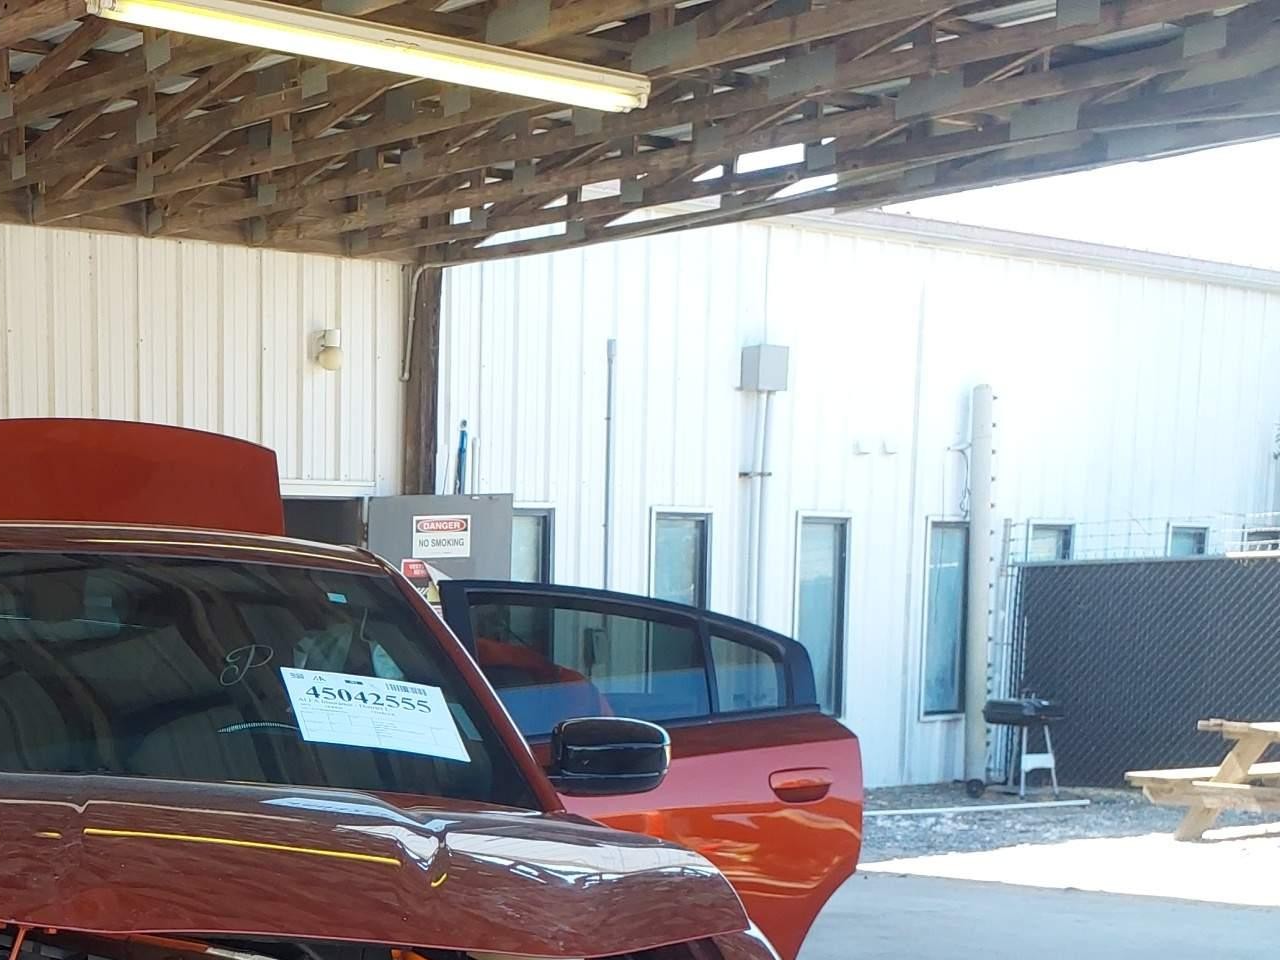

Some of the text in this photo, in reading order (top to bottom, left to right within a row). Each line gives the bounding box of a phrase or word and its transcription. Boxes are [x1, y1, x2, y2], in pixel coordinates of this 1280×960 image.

[423, 521, 460, 530] DANGER
[419, 538, 464, 547] NO SMOKING
[305, 685, 432, 714] 45042555
